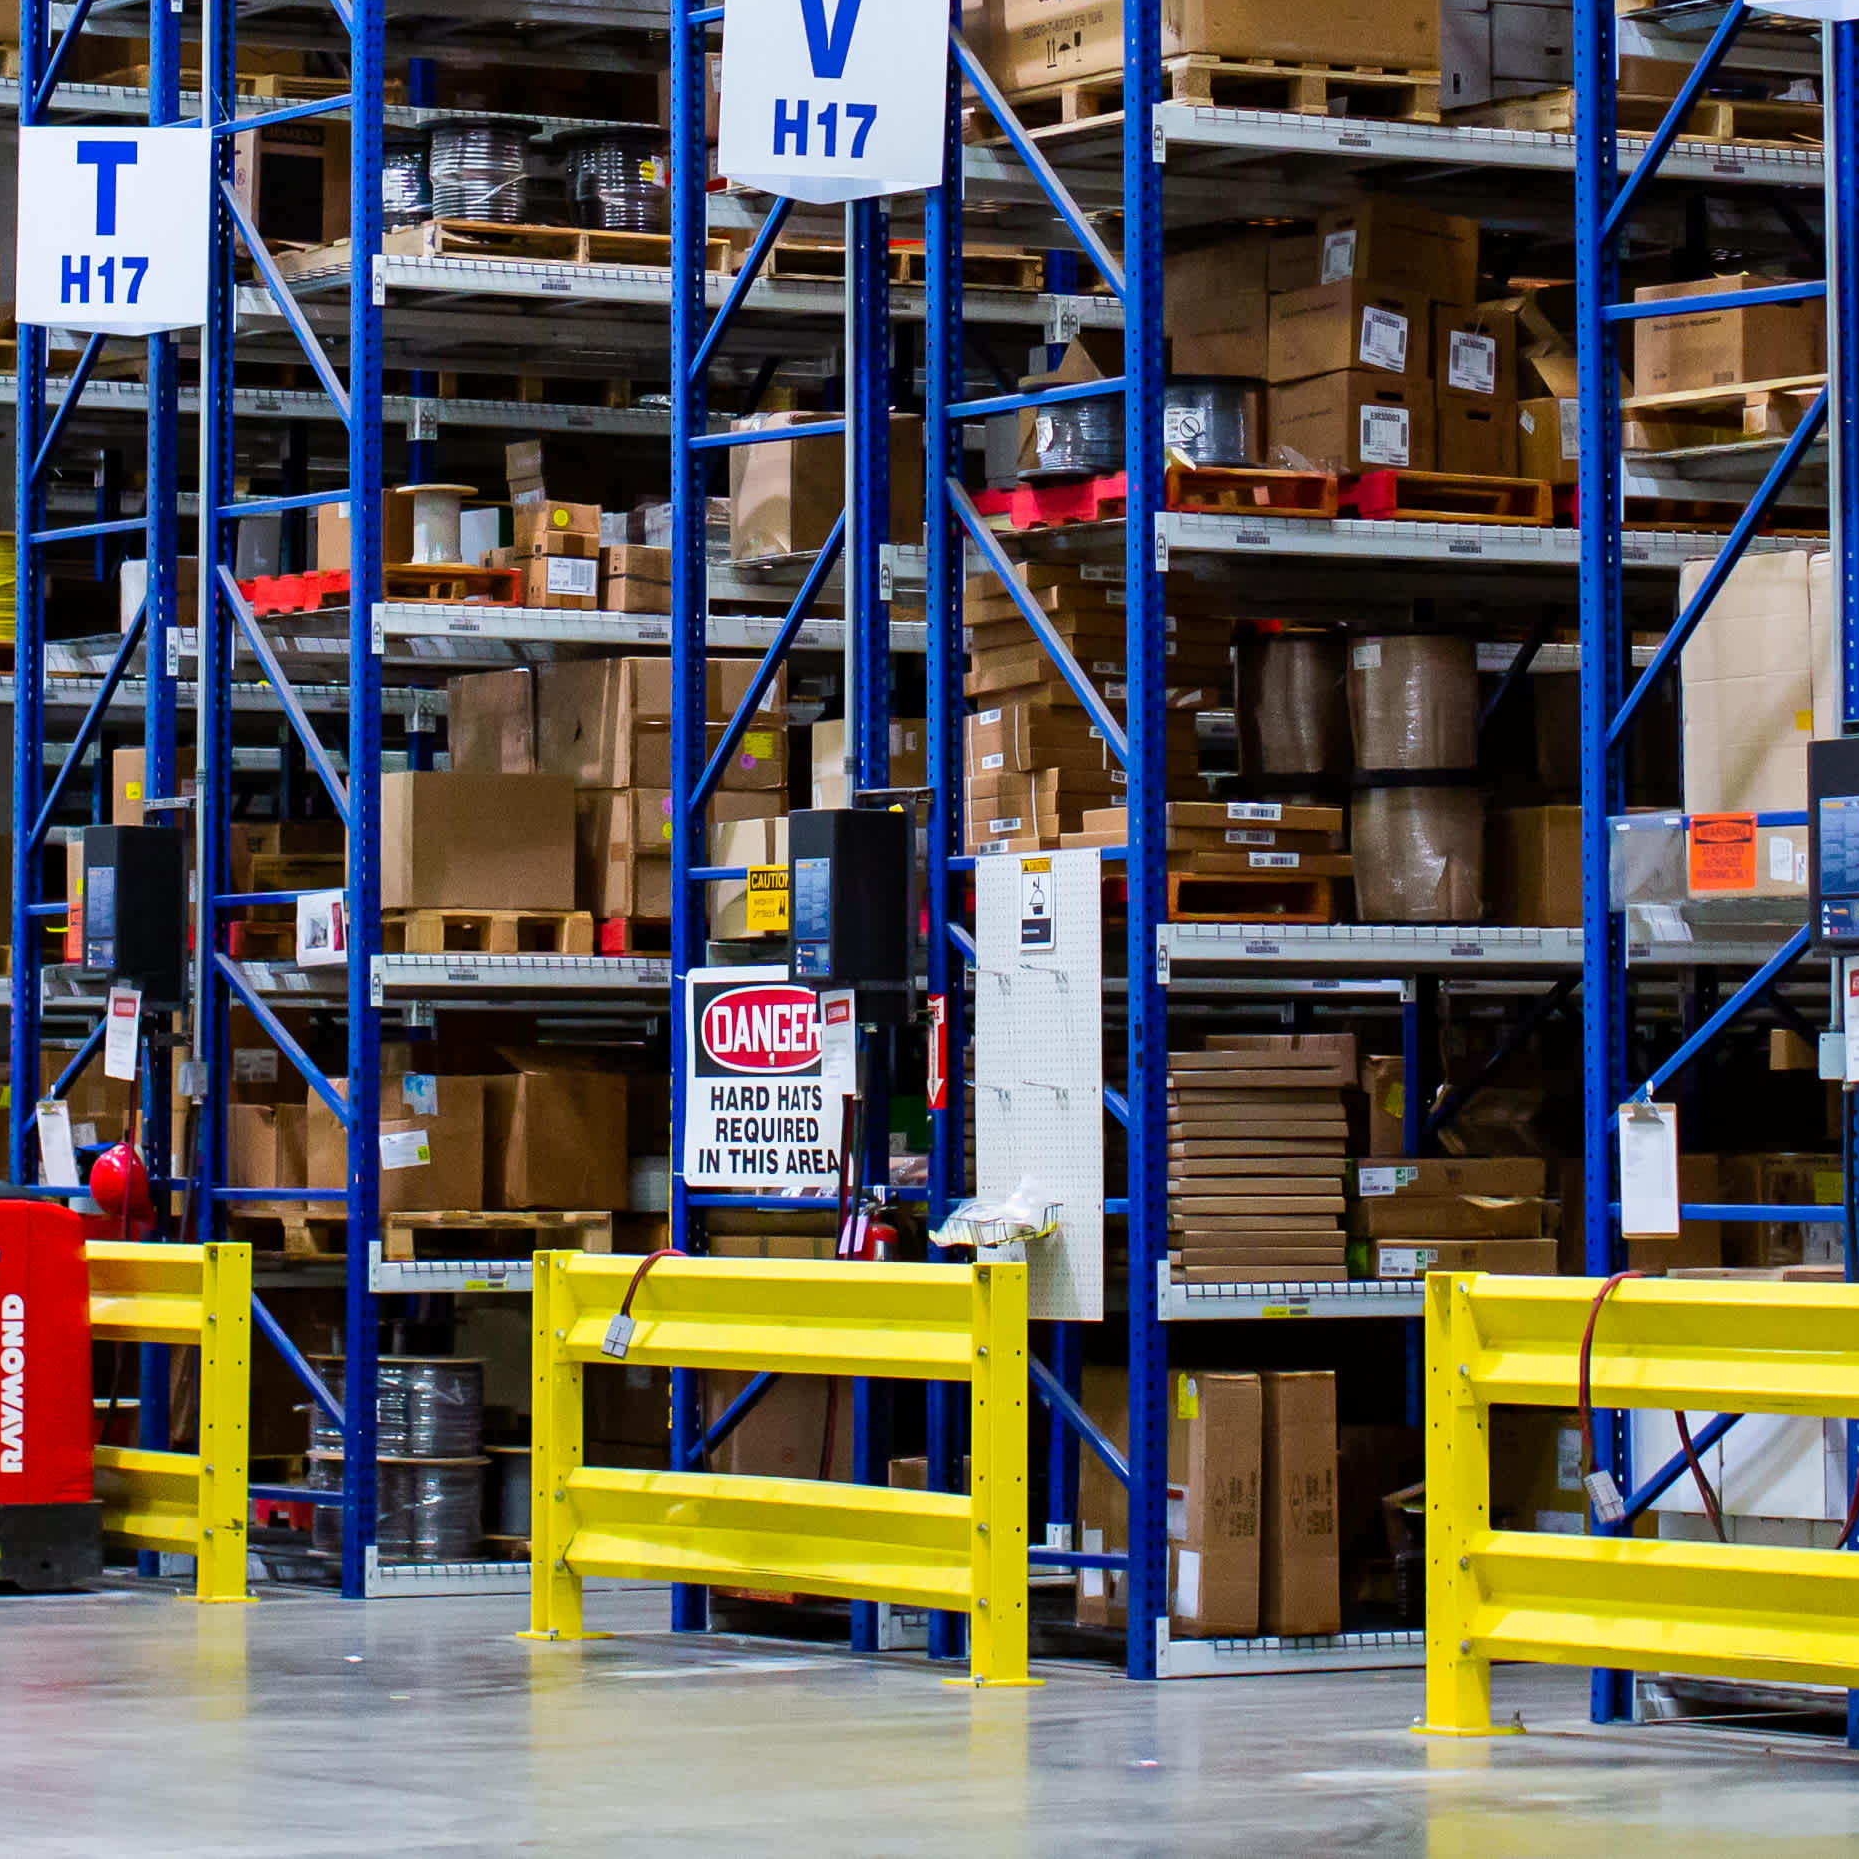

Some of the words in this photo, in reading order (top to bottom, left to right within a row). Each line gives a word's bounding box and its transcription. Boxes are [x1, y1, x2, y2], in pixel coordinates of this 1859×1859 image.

[773, 98, 878, 160] H17
[76, 140, 138, 237] T
[60, 256, 150, 305] H17
[711, 1003, 823, 1055] DANGER
[710, 1085, 771, 1112] HARD
[776, 1084, 823, 1112] HATS
[715, 1116, 820, 1144] REQUIRED
[698, 1148, 720, 1175] IN
[727, 1147, 779, 1176] THIS
[785, 1147, 841, 1176] AREA
[0, 1293, 24, 1474] RAYMOND
